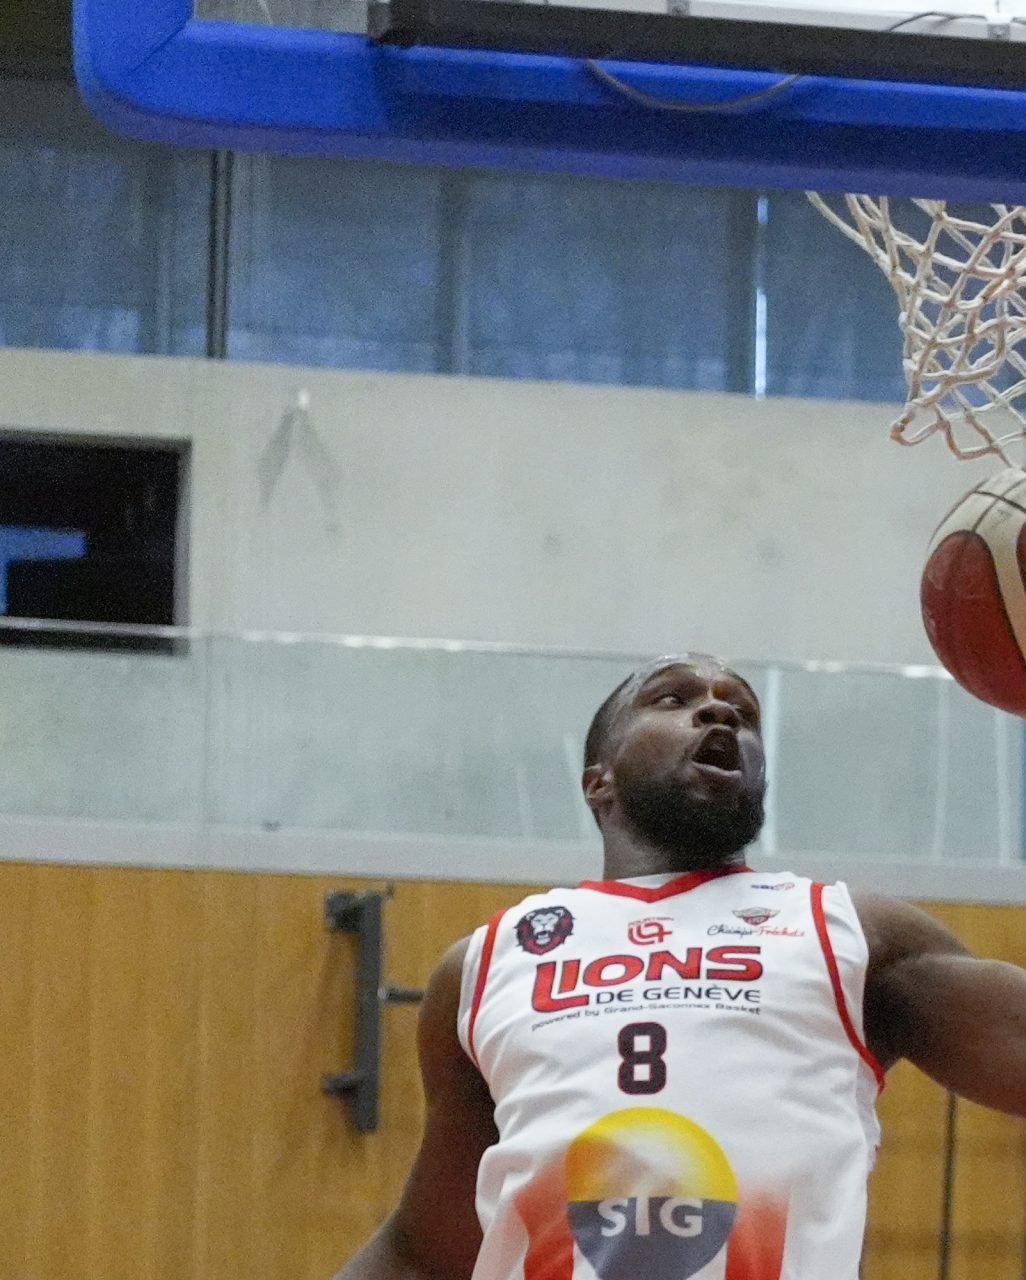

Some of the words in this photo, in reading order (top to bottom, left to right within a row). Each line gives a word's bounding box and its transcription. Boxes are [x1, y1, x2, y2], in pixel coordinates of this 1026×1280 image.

[531, 946, 763, 1013] LIONS
[596, 988, 634, 1005] DE
[643, 983, 761, 1003] GENÈVE
[531, 1011, 581, 1031] powered
[584, 1009, 600, 1017] by
[715, 1003, 761, 1016] Basket
[617, 1021, 668, 1096] 8
[598, 1195, 703, 1238] SIG
